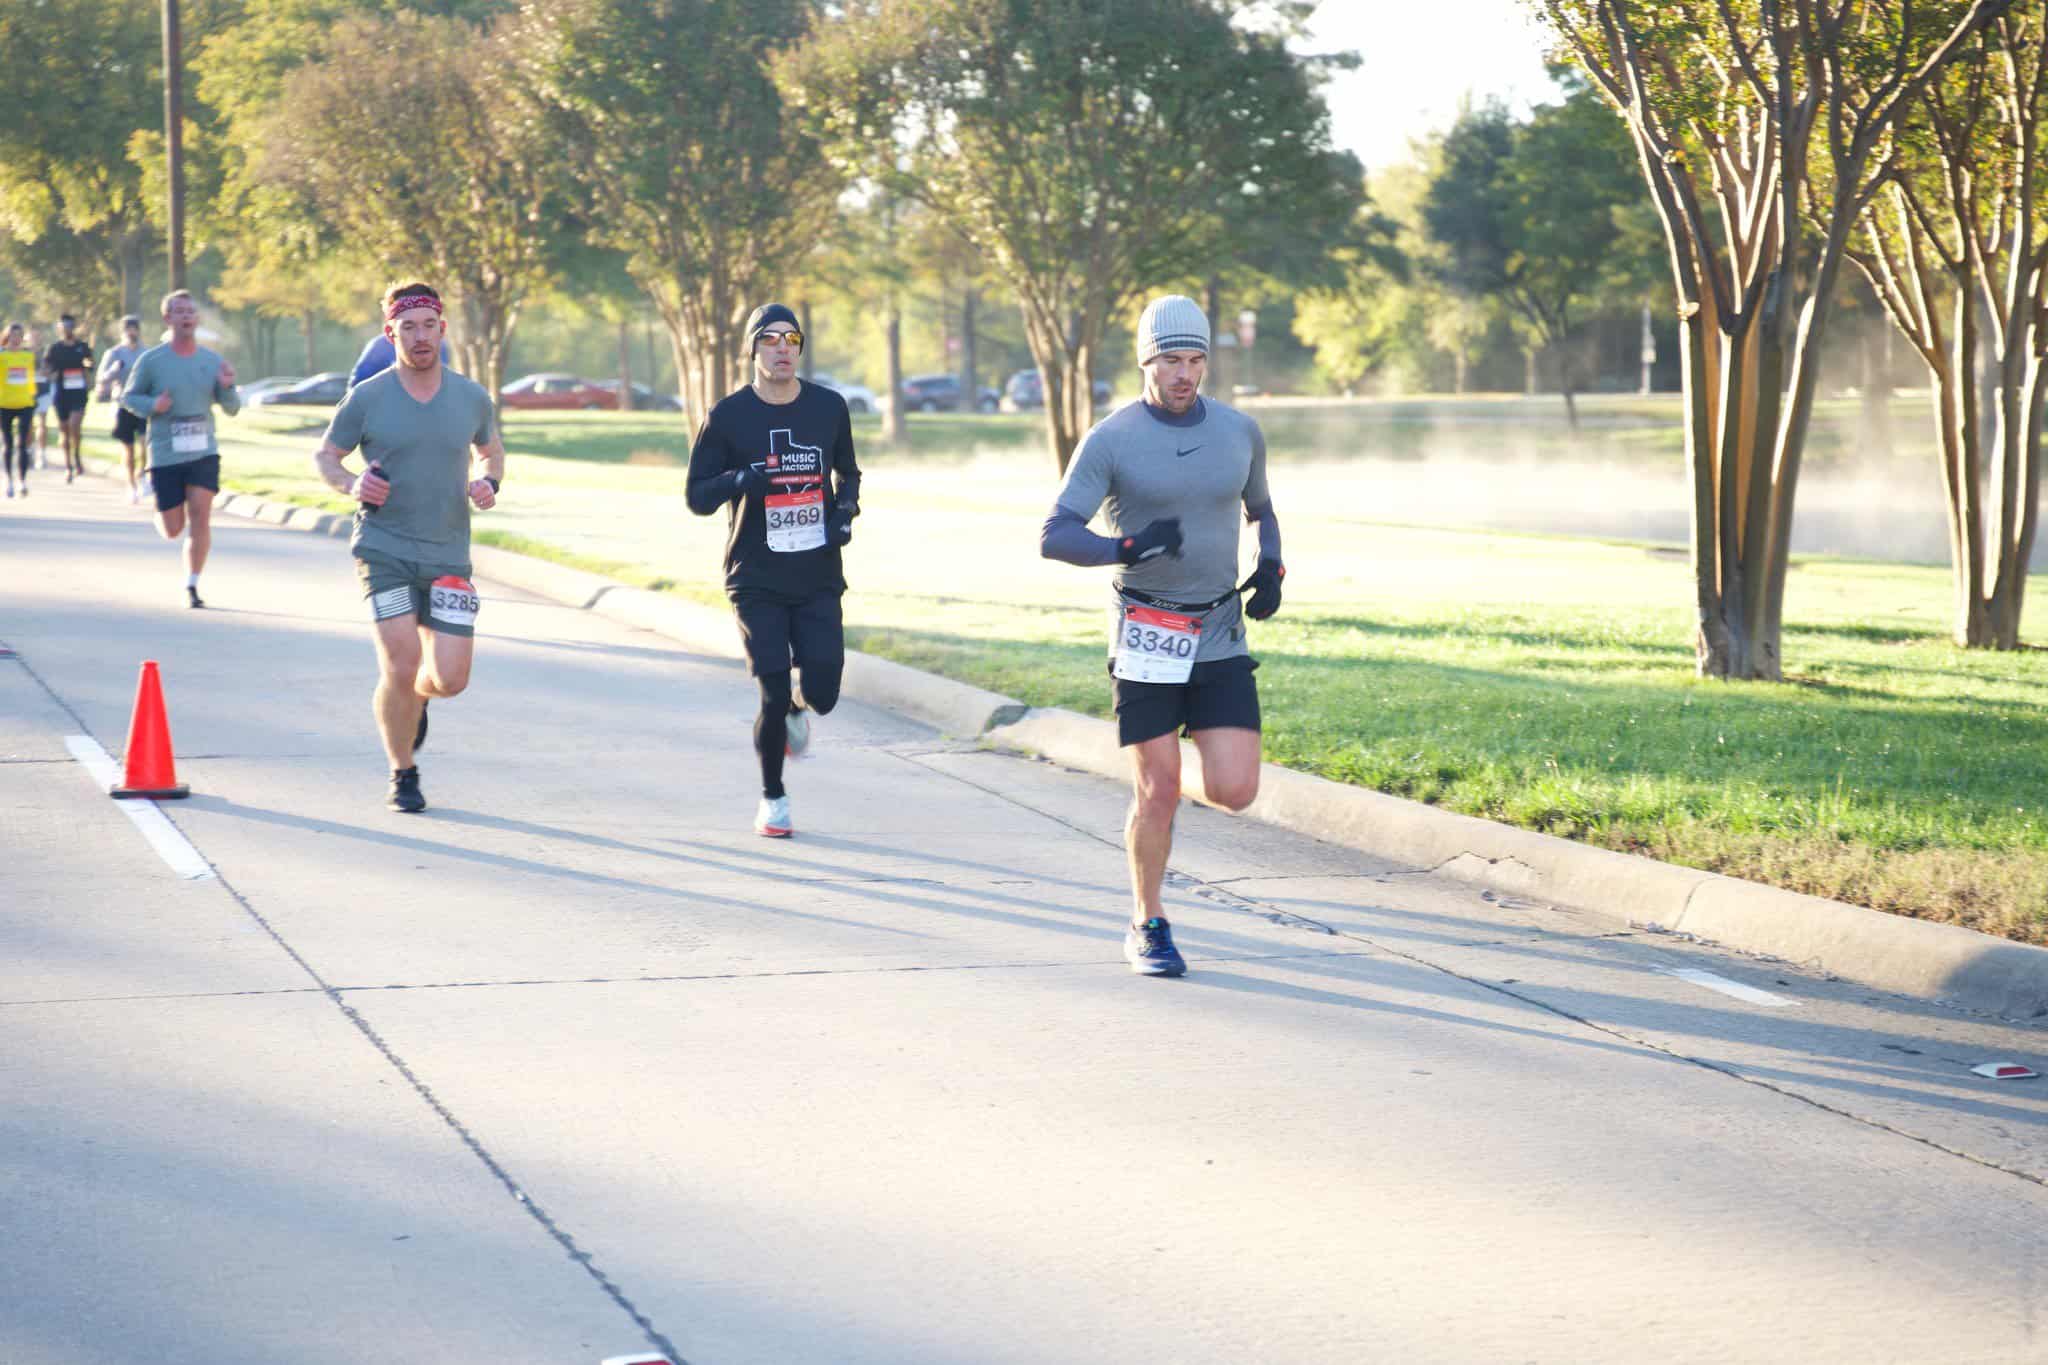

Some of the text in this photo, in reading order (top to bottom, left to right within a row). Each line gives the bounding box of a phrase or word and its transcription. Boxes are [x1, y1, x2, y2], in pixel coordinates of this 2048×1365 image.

[781, 453, 816, 464] MUSIC
[781, 463, 816, 472] FACTORY
[770, 507, 820, 529] 3469
[432, 591, 479, 612] 3285
[1126, 627, 1192, 657] 3340
